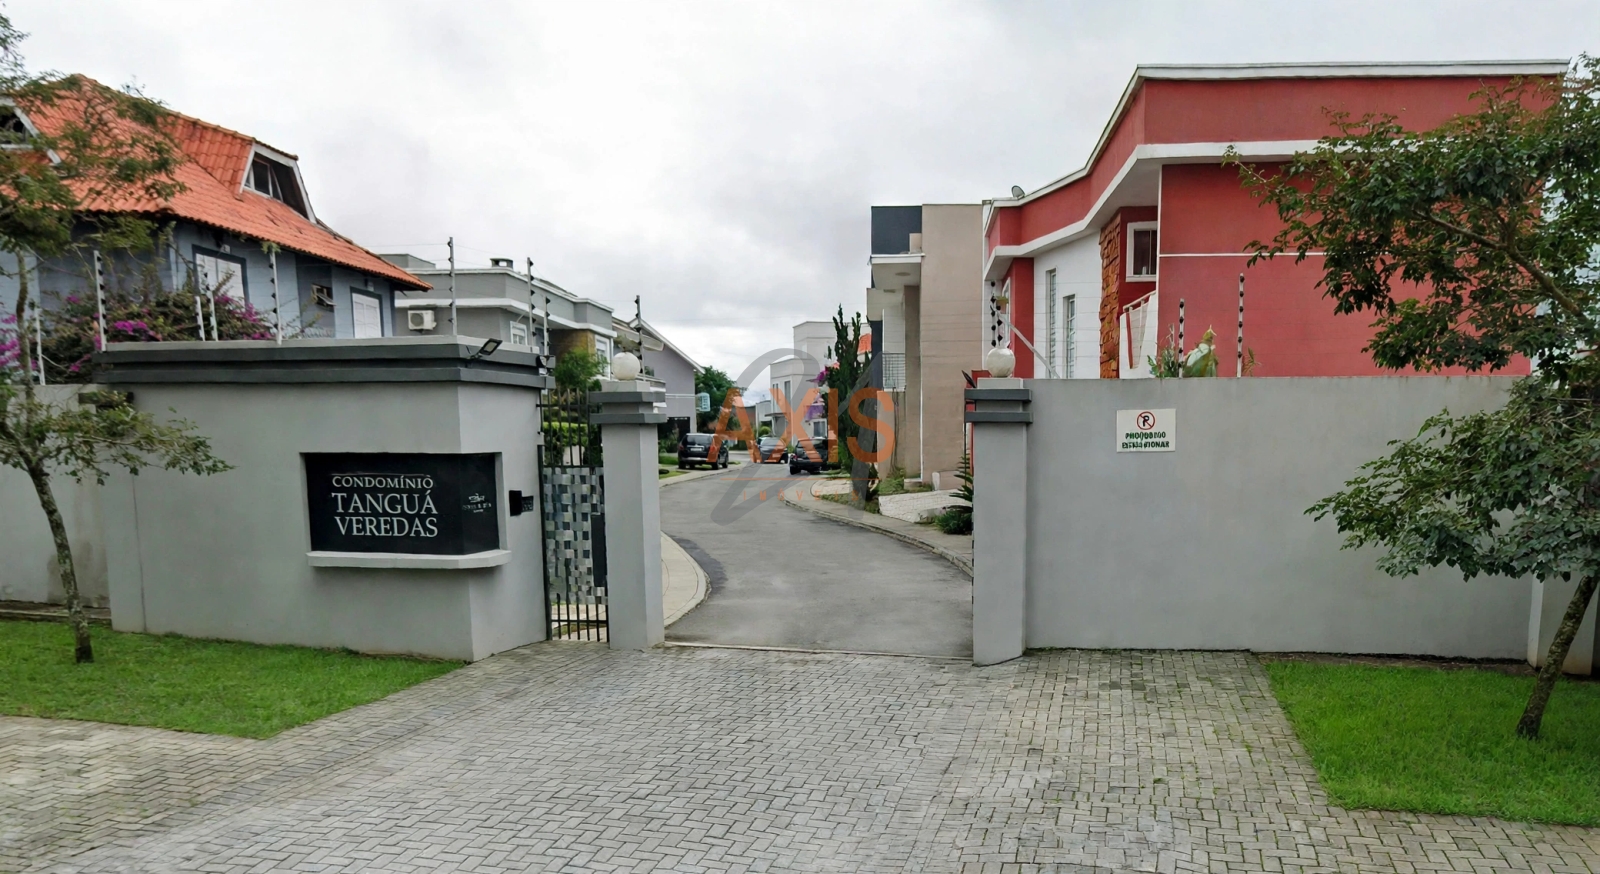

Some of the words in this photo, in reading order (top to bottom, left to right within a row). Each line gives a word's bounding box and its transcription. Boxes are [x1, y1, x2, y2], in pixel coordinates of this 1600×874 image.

[332, 475, 434, 488] CONDOMÍNIO
[331, 490, 438, 514] TANGUÁ
[334, 516, 438, 537] VEREDAS
